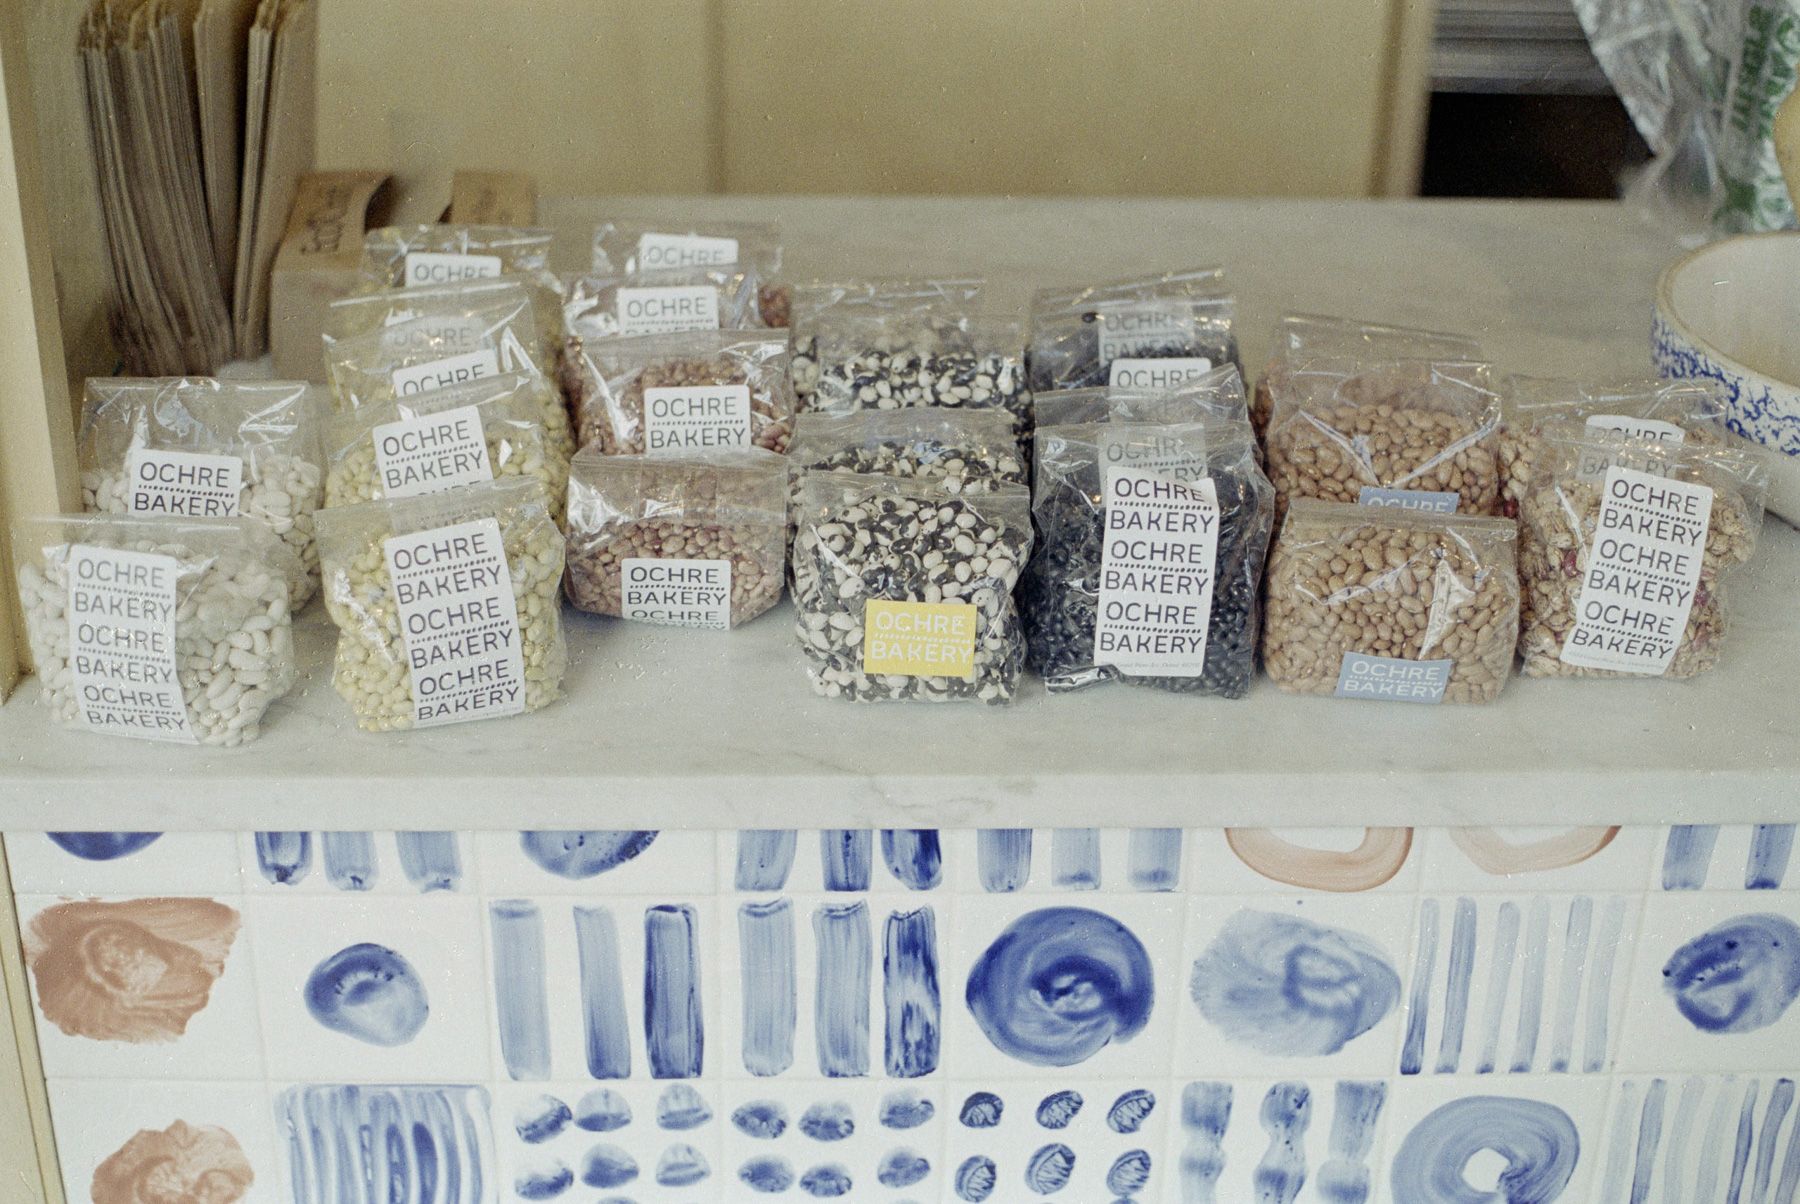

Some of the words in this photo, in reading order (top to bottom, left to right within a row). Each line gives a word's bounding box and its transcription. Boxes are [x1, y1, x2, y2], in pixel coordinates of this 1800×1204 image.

[647, 246, 725, 265] OCHRE
[414, 263, 489, 282] OCHRE
[627, 297, 707, 318] OCHRE
[1105, 312, 1186, 332] OCHR
[403, 364, 486, 396] OCHRE
[1117, 369, 1198, 389] OCHRE
[652, 396, 737, 418] OCHRE
[383, 420, 470, 456] OCHRE
[650, 428, 746, 449] BAKERY
[1107, 437, 1184, 463] OCHR
[140, 462, 230, 488] OCHRE
[386, 450, 483, 489] BAKERY
[1583, 457, 1673, 478] BAKRY
[1115, 478, 1206, 502] OCHRE
[1612, 479, 1699, 516] OCHRE
[134, 493, 235, 516] BAKERY
[1111, 510, 1214, 533] BAKERY
[1603, 509, 1702, 547] BAKERY
[394, 533, 487, 570] OCHRE
[1111, 540, 1203, 564] OCHRE
[1600, 539, 1689, 575] OCHRE
[78, 559, 164, 588] OCHRE
[397, 565, 501, 605] BAKERY
[630, 567, 719, 584] OCHRE
[1105, 570, 1208, 595] BAKERY
[628, 591, 727, 605] BAKERY
[1589, 569, 1690, 608] BAKERY
[75, 592, 172, 622] BAKERY
[408, 597, 501, 634] OCHRE
[632, 610, 718, 621] OCHRE
[1106, 601, 1197, 625] OCHRE
[1585, 601, 1674, 635] OCHRE
[876, 611, 965, 636] OCHRE
[78, 624, 163, 652] OCHRE
[411, 628, 513, 669] BAKERY
[1100, 632, 1202, 654] BAKERY
[1572, 629, 1673, 659] BAKERY
[871, 640, 973, 663] BAKERY
[77, 655, 172, 683] BAKERY
[419, 659, 509, 696] OCHRE
[1352, 661, 1440, 681] OCHRE
[84, 685, 172, 708] OCHRE
[1344, 680, 1443, 698] BAKERY
[418, 687, 519, 720] BAKERY
[87, 710, 186, 731] BAKERY
